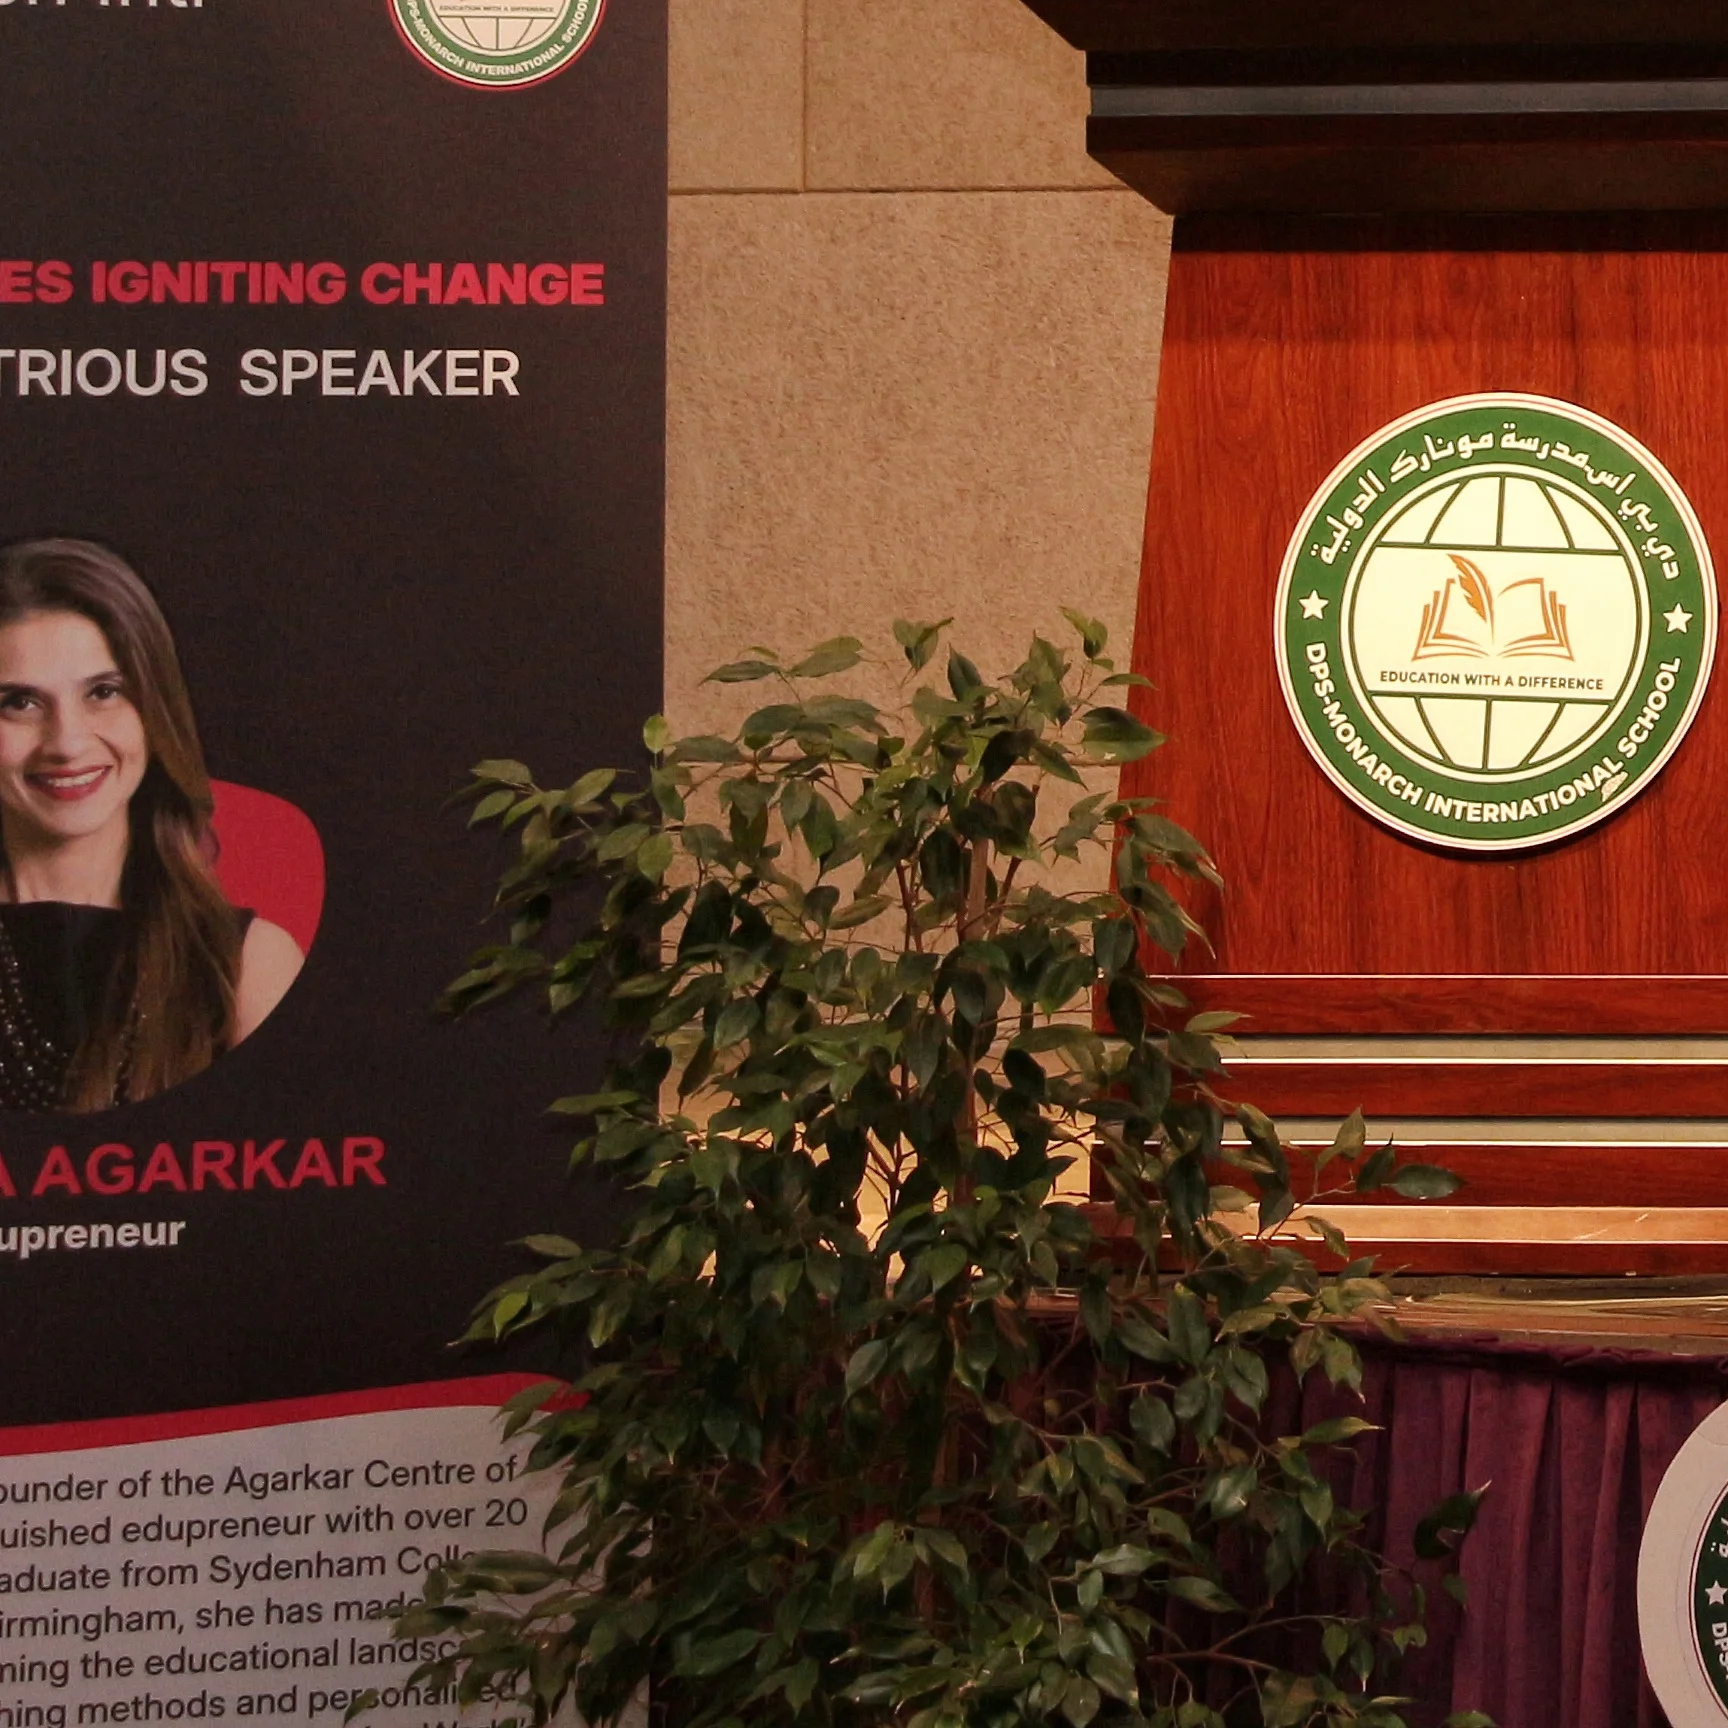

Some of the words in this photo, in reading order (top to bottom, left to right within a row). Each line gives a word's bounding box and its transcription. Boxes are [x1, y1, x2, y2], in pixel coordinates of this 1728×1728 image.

[465, 43, 564, 76] INTERNATIONAL
[92, 260, 347, 304] IGNITING
[360, 260, 605, 305] CHANGE
[239, 348, 521, 396] SPEAKER
[1390, 432, 1494, 484] مونارك
[1310, 469, 1386, 565] الدولية
[1380, 671, 1460, 685] EDUCATION
[1464, 673, 1500, 686] WITH
[1504, 675, 1515, 687] A
[1518, 675, 1604, 690] DIFFERENCE
[1306, 641, 1423, 805] DPS-MONARCH
[1425, 757, 1624, 822] INTERNATIONAL
[1618, 657, 1681, 759] SCHOOL
[32, 1137, 386, 1196] AGARKAR
[119, 1470, 152, 1499] of
[161, 1468, 214, 1496] the
[224, 1463, 354, 1500] Agarkar
[364, 1459, 476, 1489] Centre
[486, 1454, 519, 1484] of
[0, 1516, 111, 1549] uished
[122, 1514, 316, 1547] edupreneur
[326, 1503, 393, 1534] with
[404, 1506, 475, 1531] over
[485, 1497, 528, 1527] 20
[122, 1559, 198, 1588] from
[209, 1551, 386, 1589] Sydenham
[196, 1600, 254, 1629] she
[266, 1597, 323, 1625] has
[80, 1650, 134, 1679] the
[145, 1638, 339, 1676] educational
[79, 1690, 226, 1723] methods
[236, 1685, 298, 1716] and
